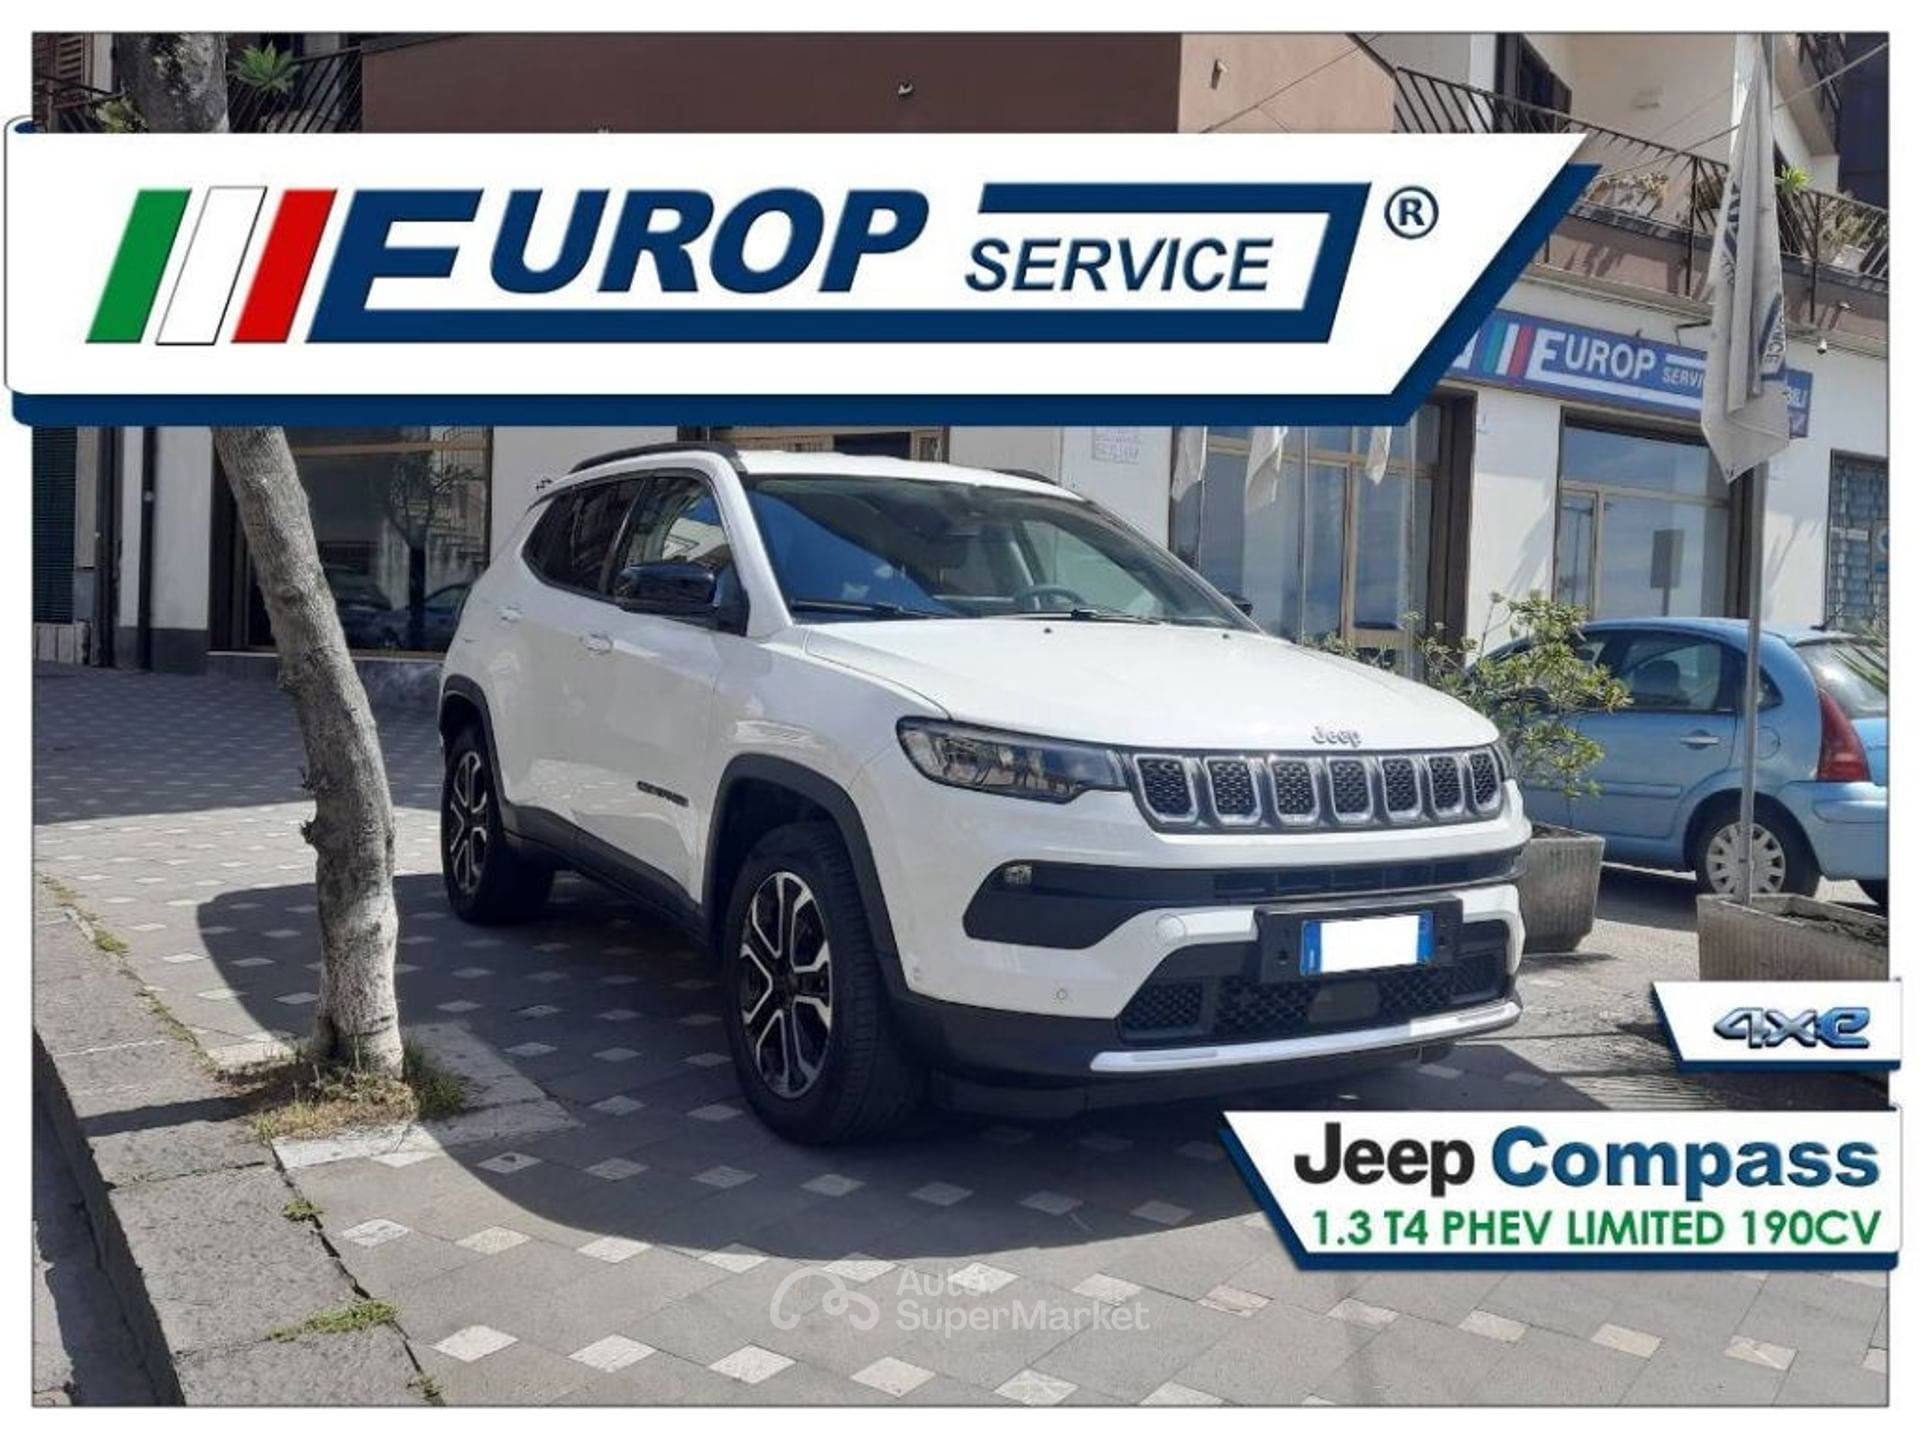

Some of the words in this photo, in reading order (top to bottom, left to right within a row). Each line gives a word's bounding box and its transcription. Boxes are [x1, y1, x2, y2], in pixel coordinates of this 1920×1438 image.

[1524, 328, 1656, 380] EUROP
[1661, 365, 1706, 390] SERVI
[1310, 724, 1363, 749] Jeep
